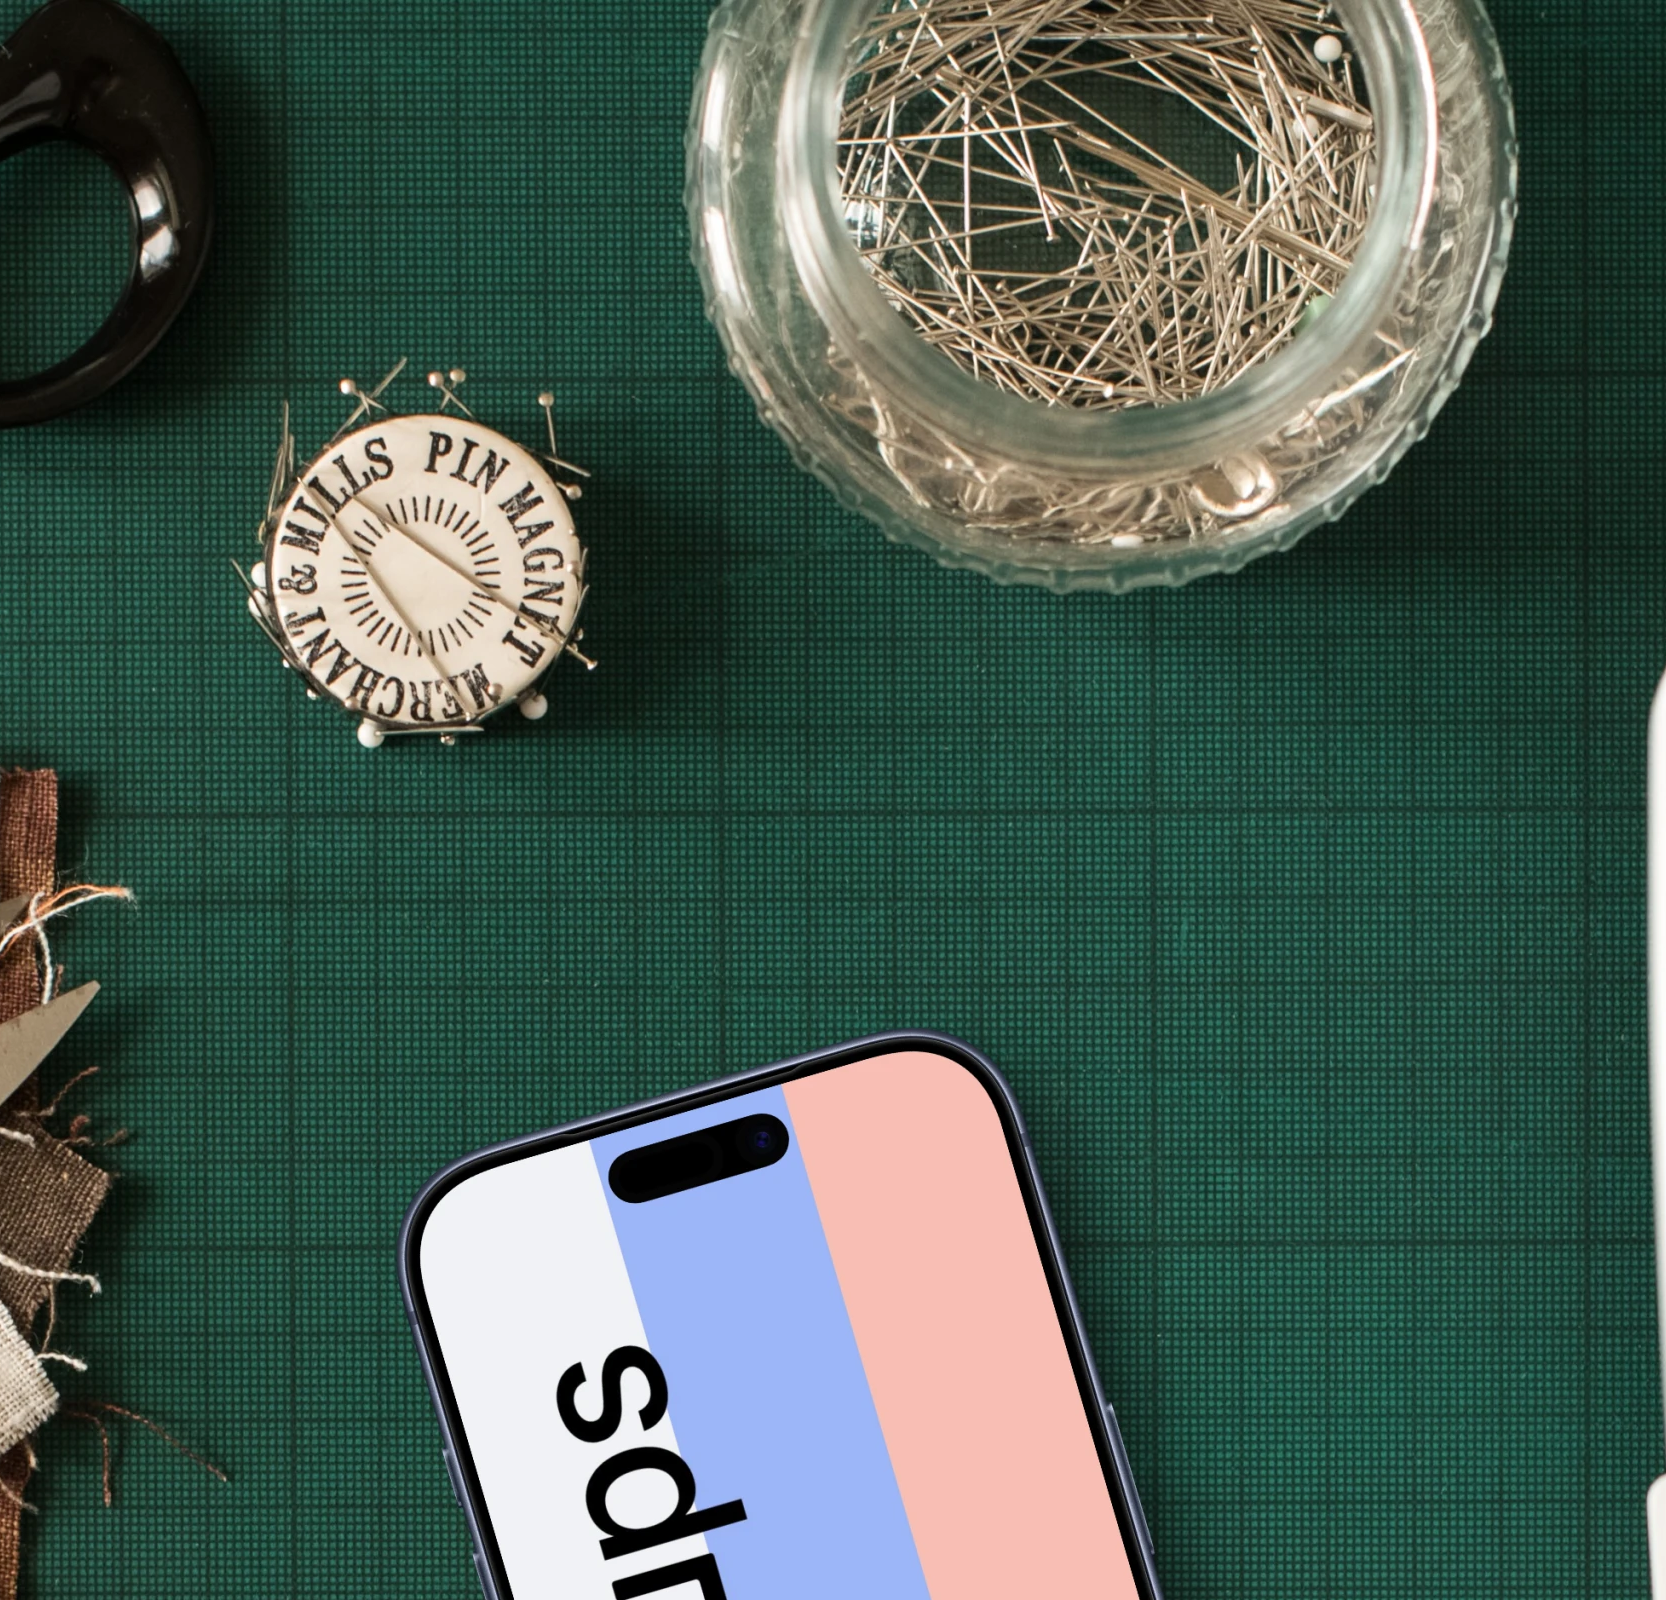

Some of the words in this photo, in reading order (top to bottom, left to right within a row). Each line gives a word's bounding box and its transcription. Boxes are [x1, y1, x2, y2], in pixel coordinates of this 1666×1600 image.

[280, 437, 395, 555] MILLS
[424, 431, 511, 494] PIN
[278, 563, 319, 595] &
[498, 481, 567, 668] MAGNET
[284, 607, 494, 721] MERCHANT
